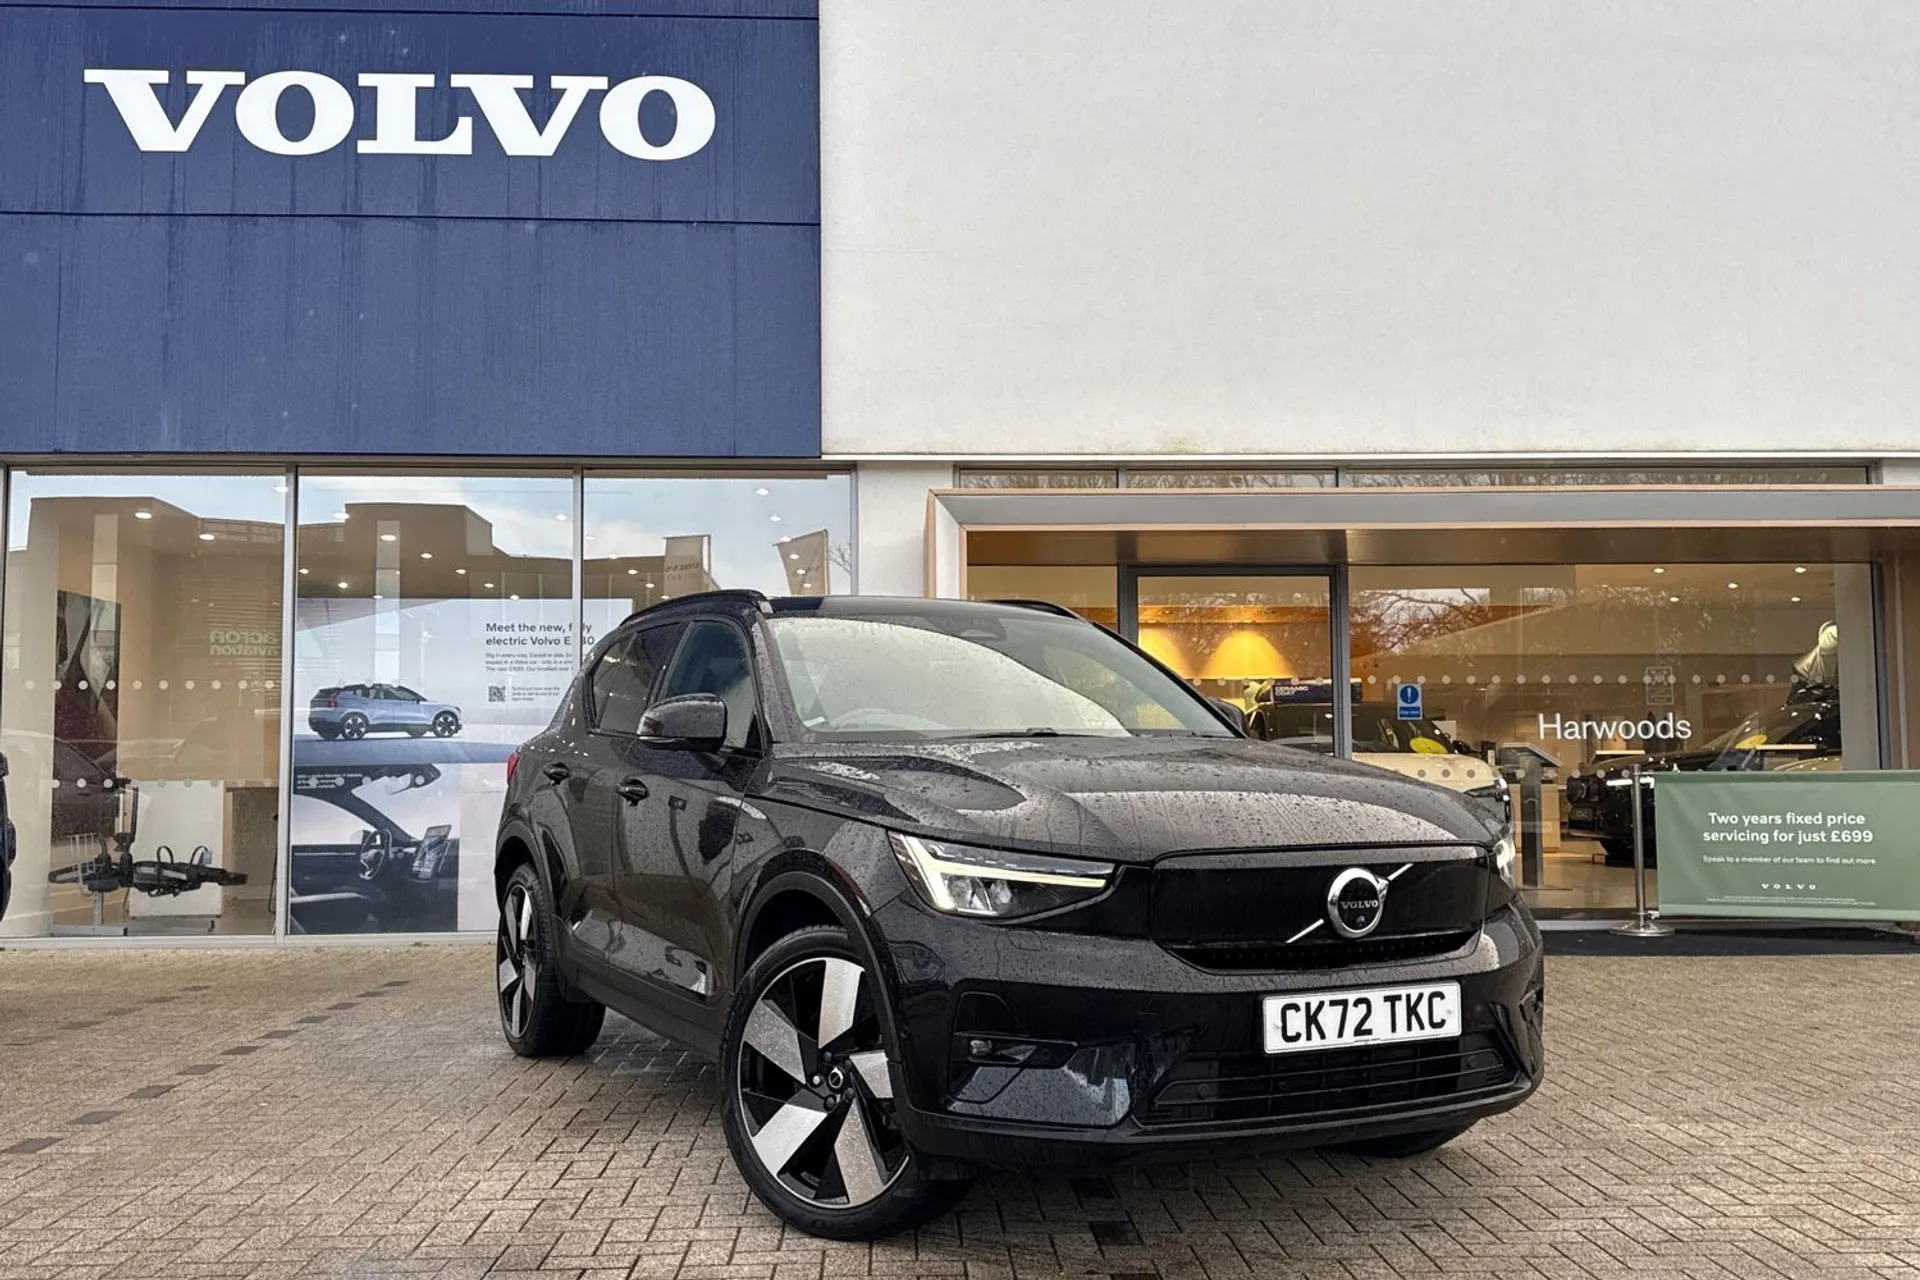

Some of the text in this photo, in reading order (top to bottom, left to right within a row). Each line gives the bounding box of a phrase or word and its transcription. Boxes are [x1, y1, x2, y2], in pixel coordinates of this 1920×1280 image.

[84, 70, 716, 161] VOLVO
[486, 623, 515, 632] Meet
[518, 623, 537, 632] the
[540, 624, 565, 633] new,
[486, 636, 595, 645] electric Volvo E30
[1538, 712, 1692, 740] Harwoods
[1708, 812, 1865, 827] Two years fixed price
[1703, 829, 1874, 845] servicing for just £699
[1703, 855, 1725, 864] Speak
[1741, 855, 1771, 863] member
[1825, 856, 1840, 864] find
[1841, 857, 1854, 865] out
[1340, 900, 1379, 909] VOLVO
[1281, 991, 1446, 1043] CK72 TKC
